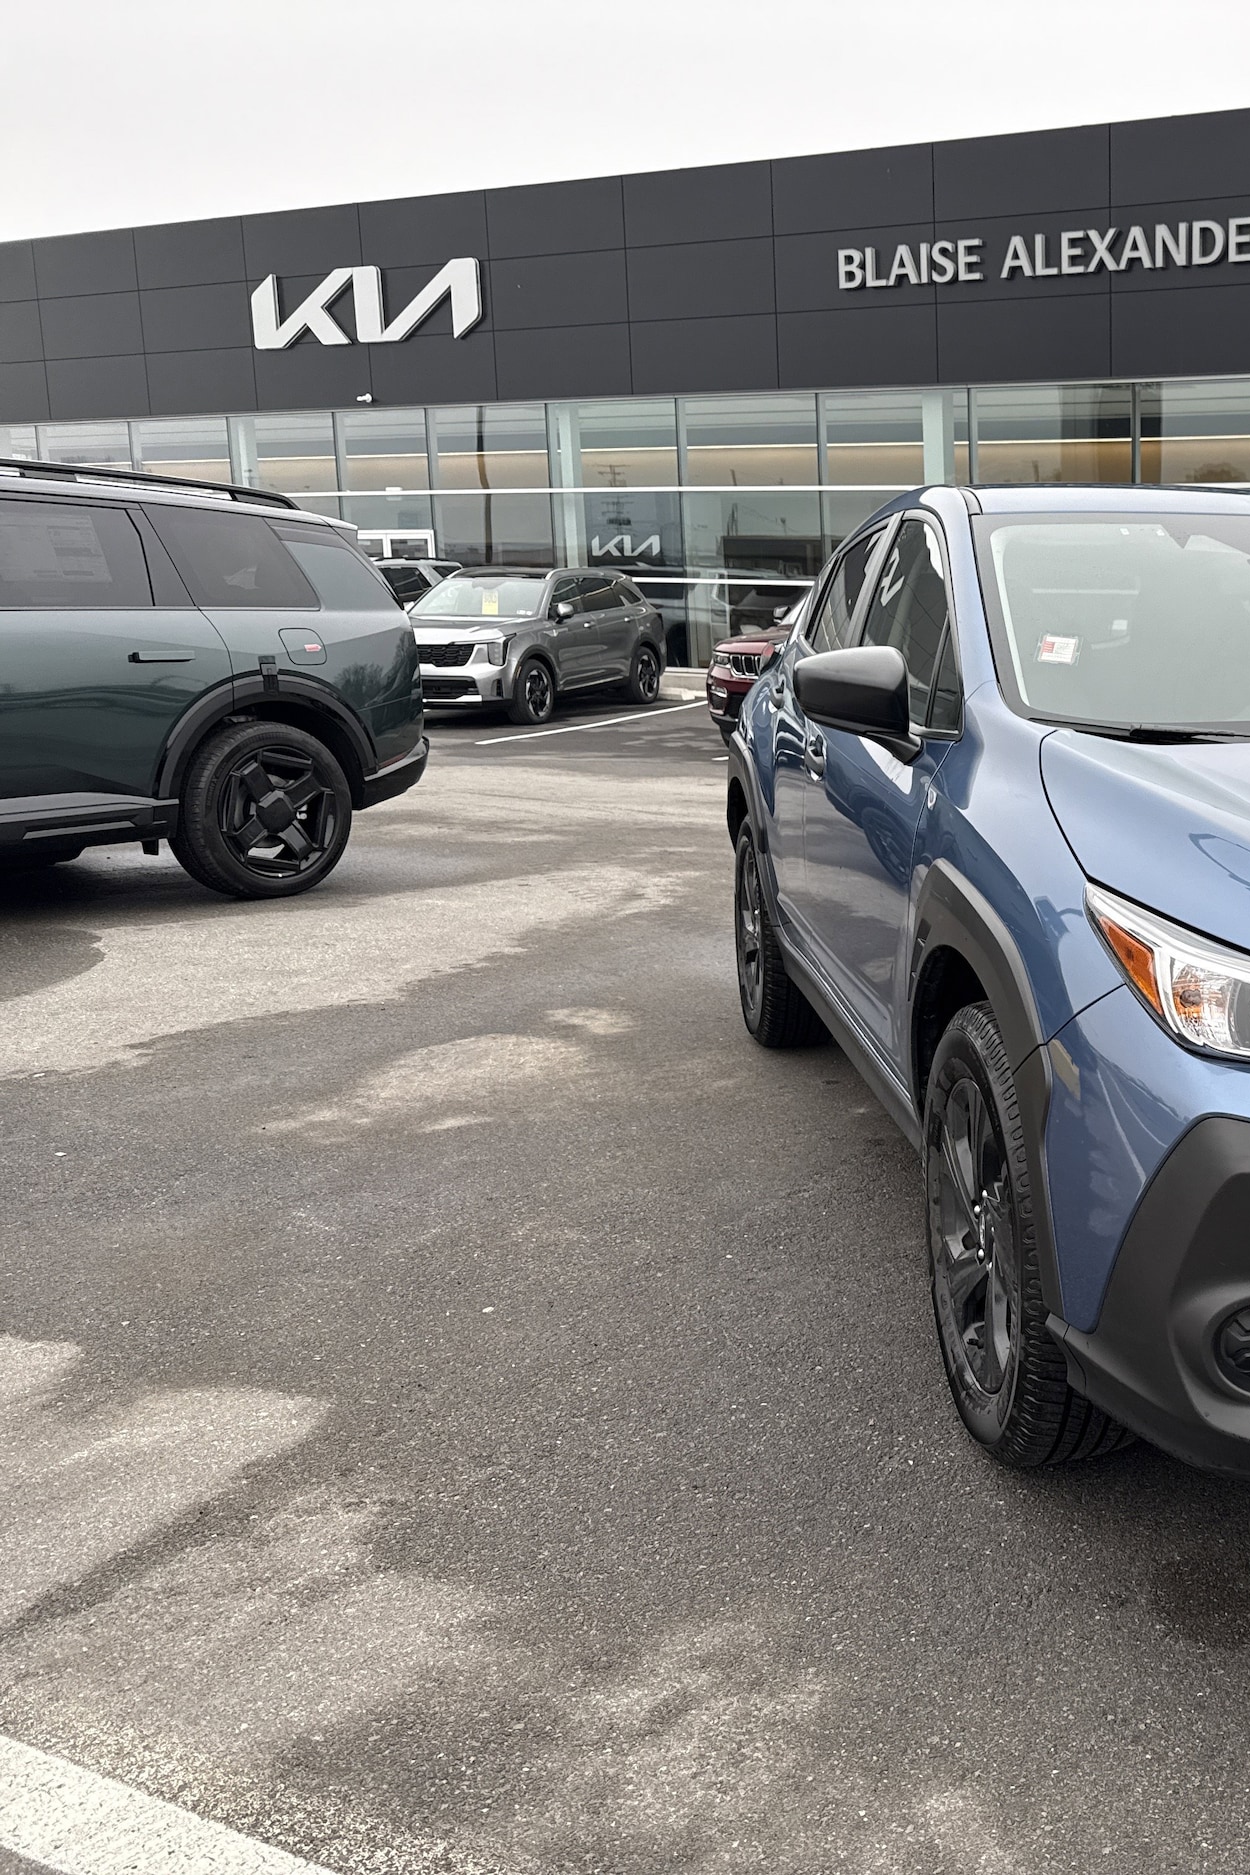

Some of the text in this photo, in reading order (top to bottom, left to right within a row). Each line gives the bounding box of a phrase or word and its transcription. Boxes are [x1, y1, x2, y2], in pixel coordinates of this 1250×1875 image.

[836, 238, 984, 291] BLAISE
[250, 256, 483, 351] KIA
[591, 534, 661, 557] KIA
